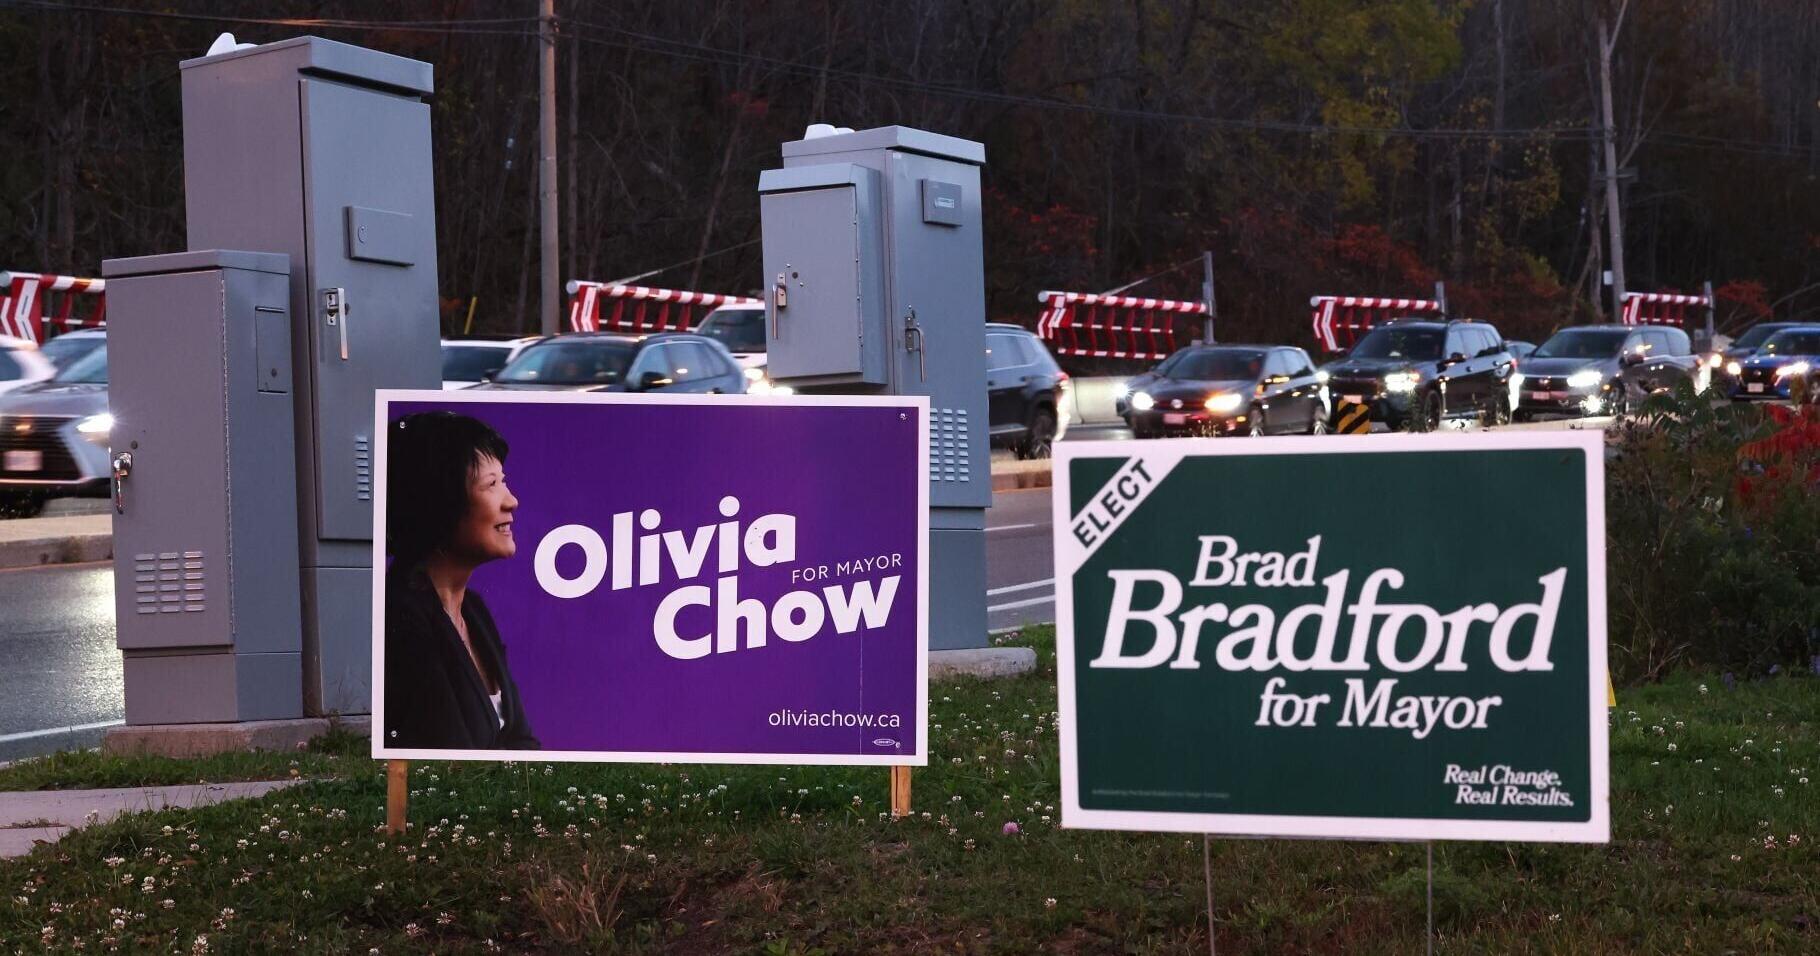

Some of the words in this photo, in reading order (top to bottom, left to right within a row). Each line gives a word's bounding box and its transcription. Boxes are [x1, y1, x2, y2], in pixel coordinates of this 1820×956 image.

[1073, 459, 1153, 548] ELECT
[533, 495, 796, 599] Olivia
[792, 565, 828, 584] FOR
[837, 553, 902, 577] MAYOR
[1189, 535, 1321, 588] Brad
[653, 575, 902, 660] Chow
[1090, 567, 1568, 673] Bradford
[768, 709, 900, 728] oliviachow.ca
[1254, 677, 1330, 728] for
[1337, 678, 1503, 739] Mayor
[1443, 764, 1486, 784] Real
[1489, 765, 1562, 788] Change.
[1456, 786, 1498, 804] Real
[1502, 786, 1574, 807] Results.
